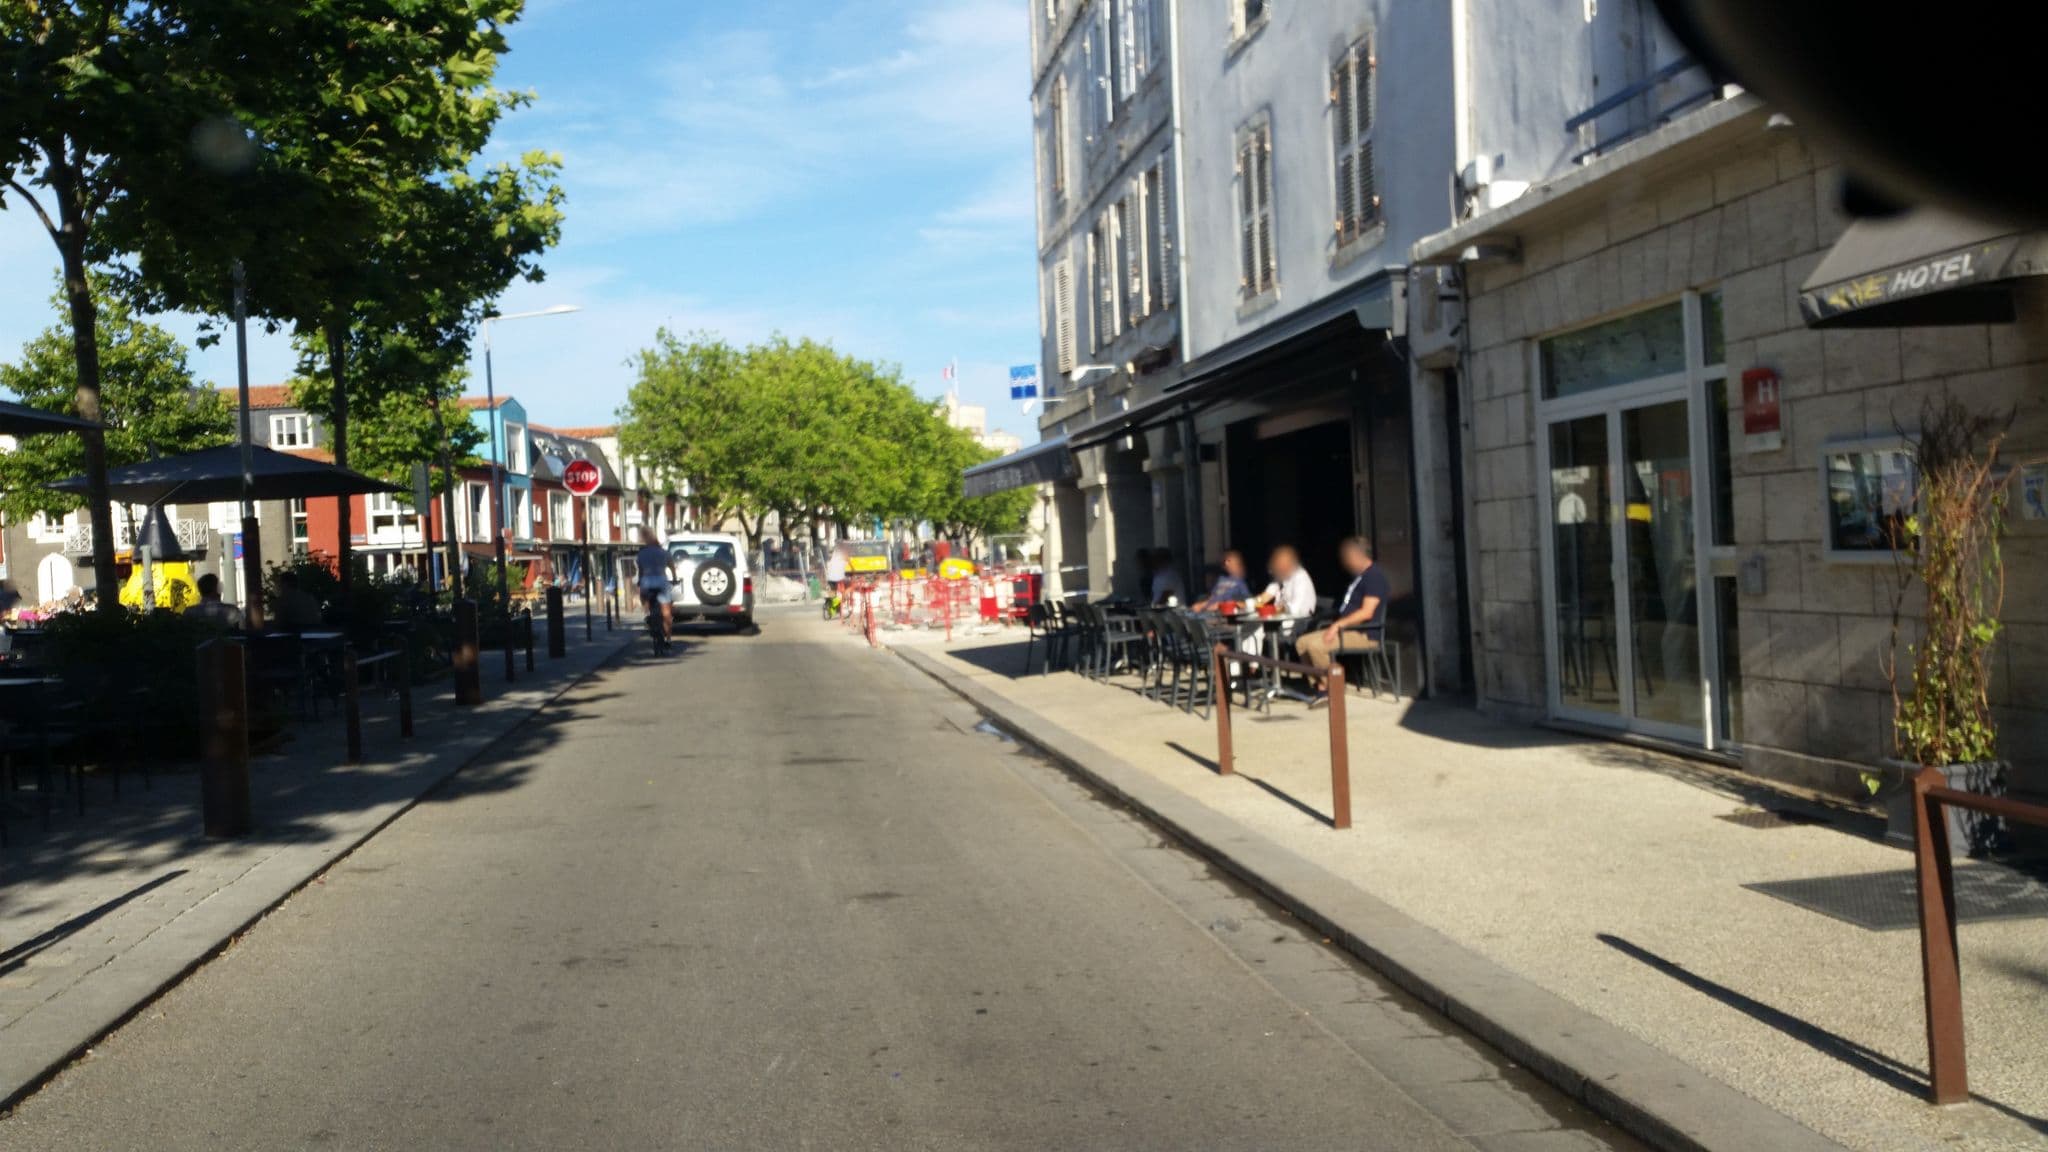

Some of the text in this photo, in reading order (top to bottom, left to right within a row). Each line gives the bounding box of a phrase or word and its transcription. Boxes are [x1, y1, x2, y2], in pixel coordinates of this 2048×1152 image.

[1890, 253, 1974, 294] HOTEL
[1758, 380, 1775, 403] H
[567, 469, 597, 484] STOP
